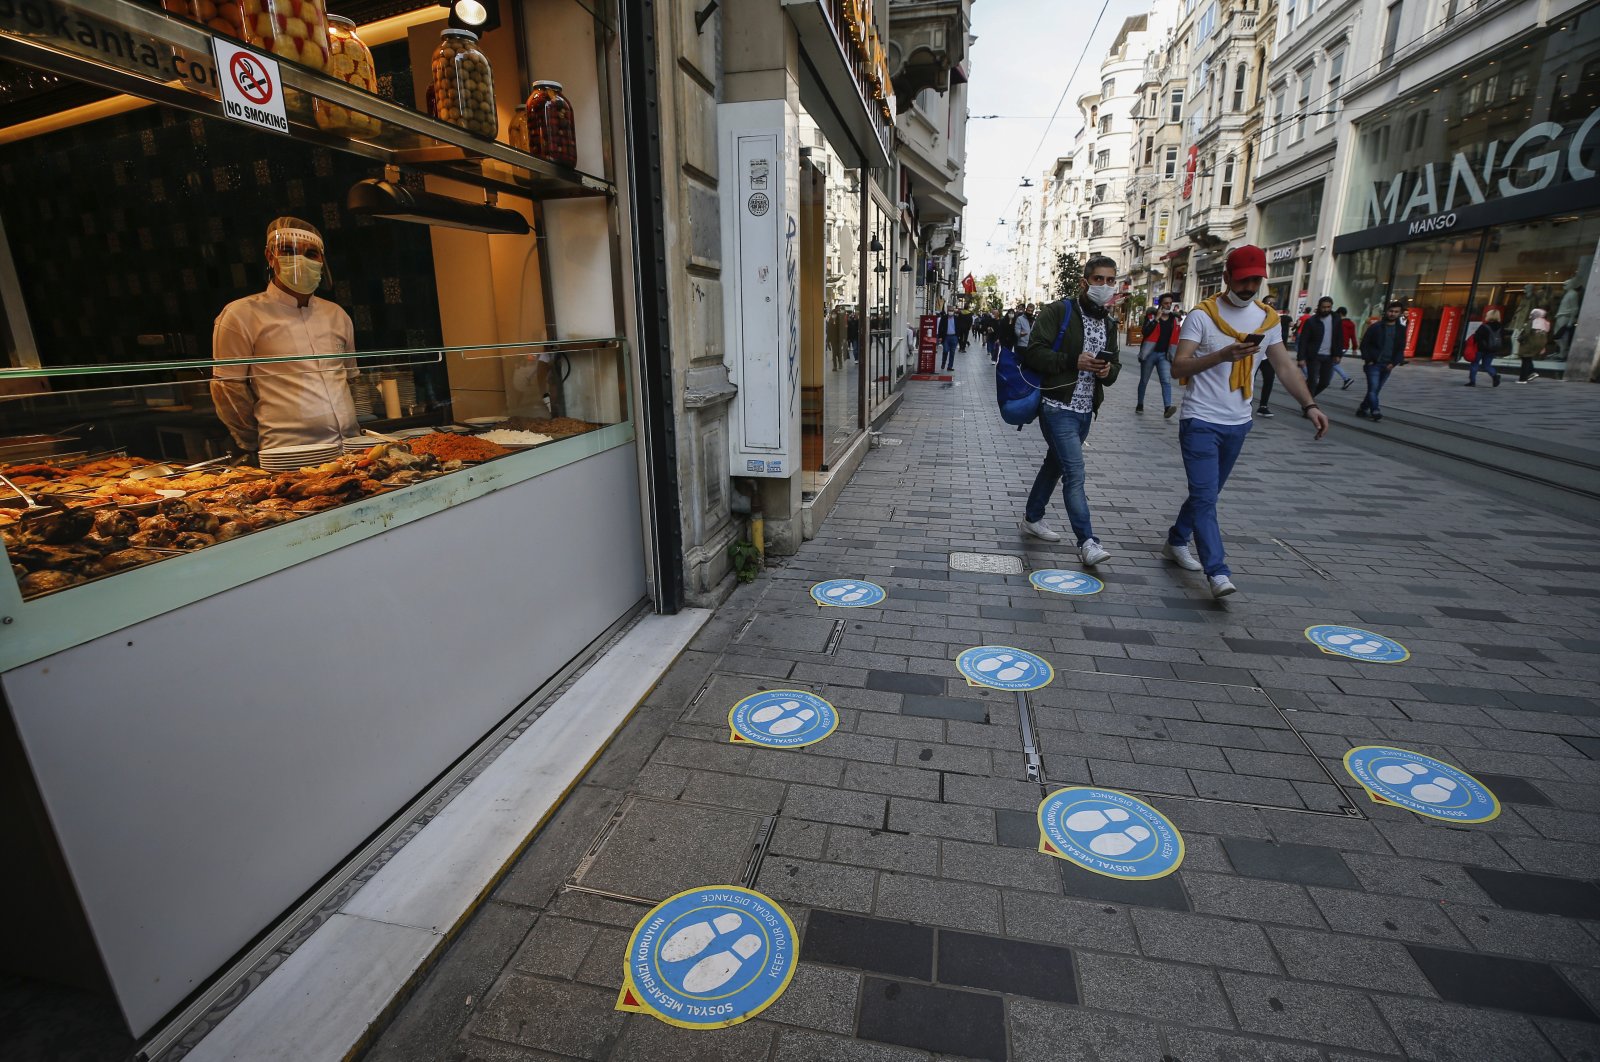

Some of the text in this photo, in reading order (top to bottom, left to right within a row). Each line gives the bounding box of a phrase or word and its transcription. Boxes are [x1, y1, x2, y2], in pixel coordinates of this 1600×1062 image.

[227, 100, 287, 130] NO SMOKING
[1408, 213, 1457, 235] MANGO
[1089, 791, 1133, 806] DISTANCE
[1136, 804, 1162, 825] SOCIAL
[1161, 842, 1173, 860] KEEP
[1097, 860, 1137, 872] SOSYAL
[702, 894, 786, 978] KEEP YOUR SOCIAL DISTANCE
[636, 917, 734, 1016] SOSYAL MESAFENİZİ KORUYUN
